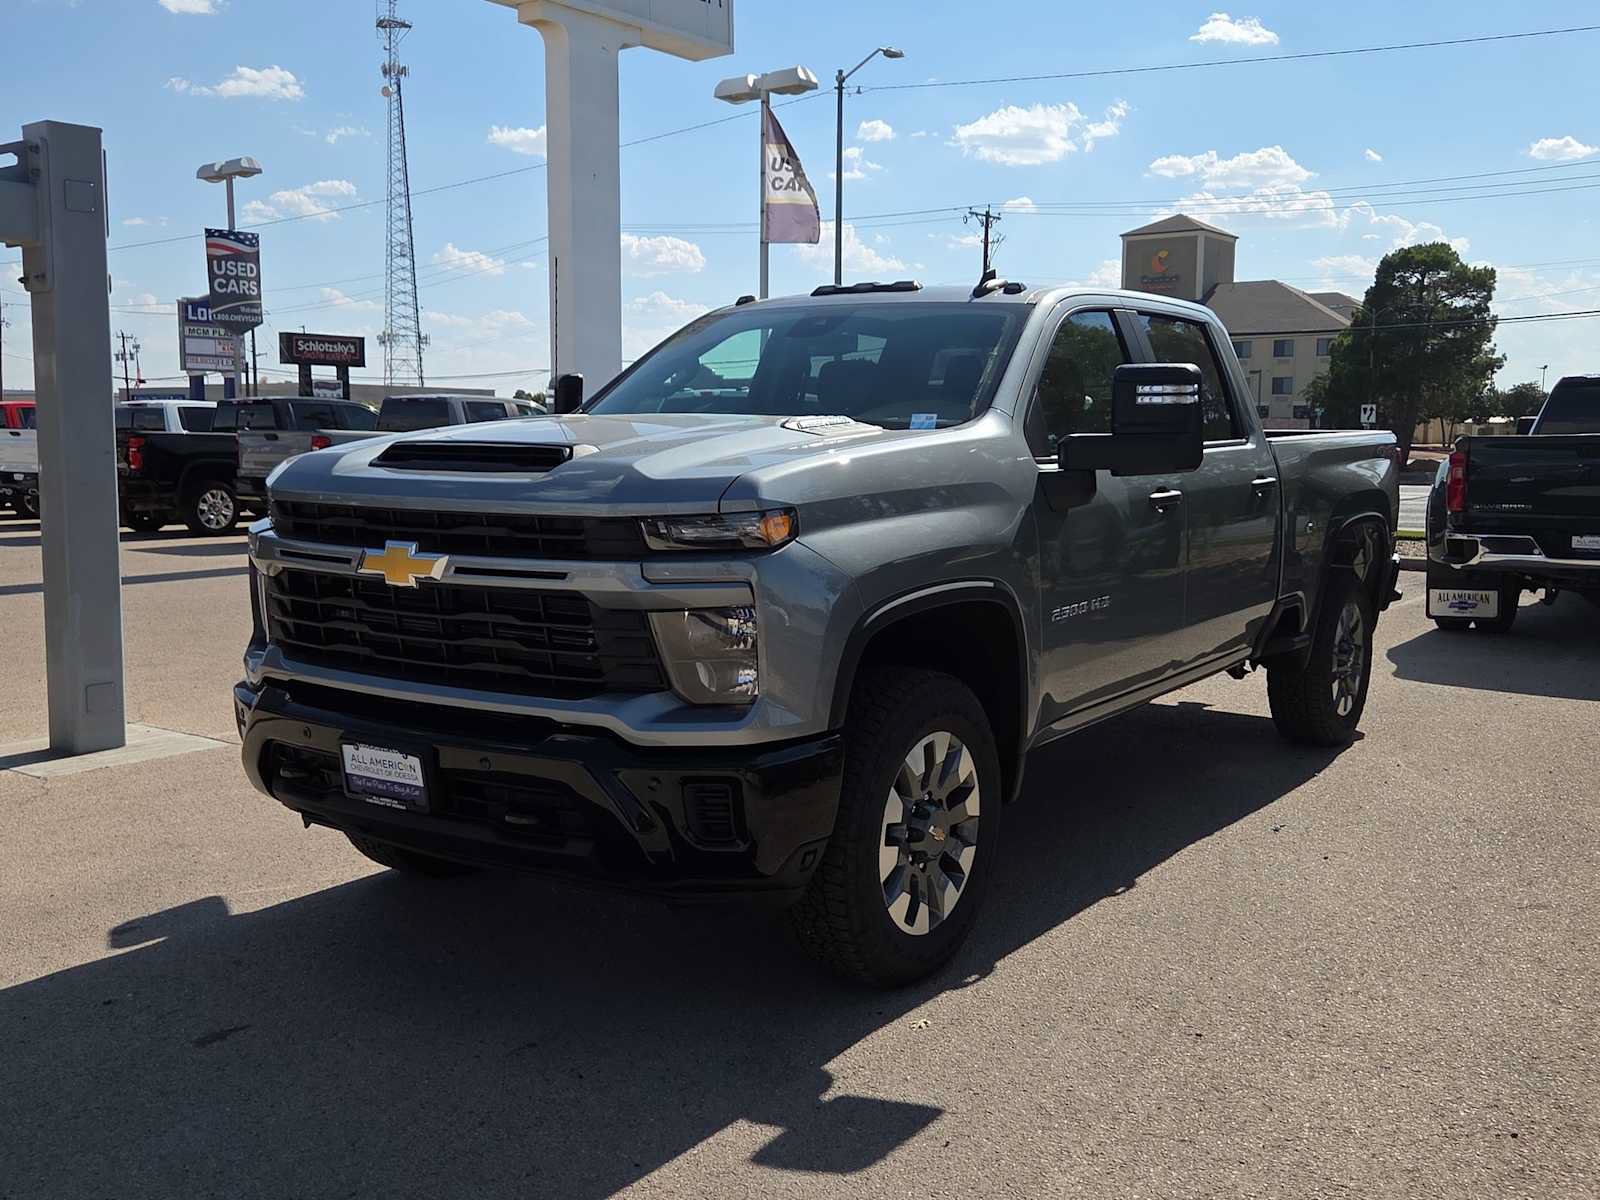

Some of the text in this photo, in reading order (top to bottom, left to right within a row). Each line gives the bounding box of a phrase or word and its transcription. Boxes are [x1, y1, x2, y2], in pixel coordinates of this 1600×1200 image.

[771, 177, 802, 191] CA
[213, 260, 257, 277] USED
[214, 278, 258, 296] CARS
[187, 304, 212, 321] Lo
[297, 340, 355, 354] Schlotzsky's
[1438, 592, 1491, 604] ALL AMERICAN
[1051, 595, 1110, 622] 2500 HD
[351, 753, 367, 765] ALL
